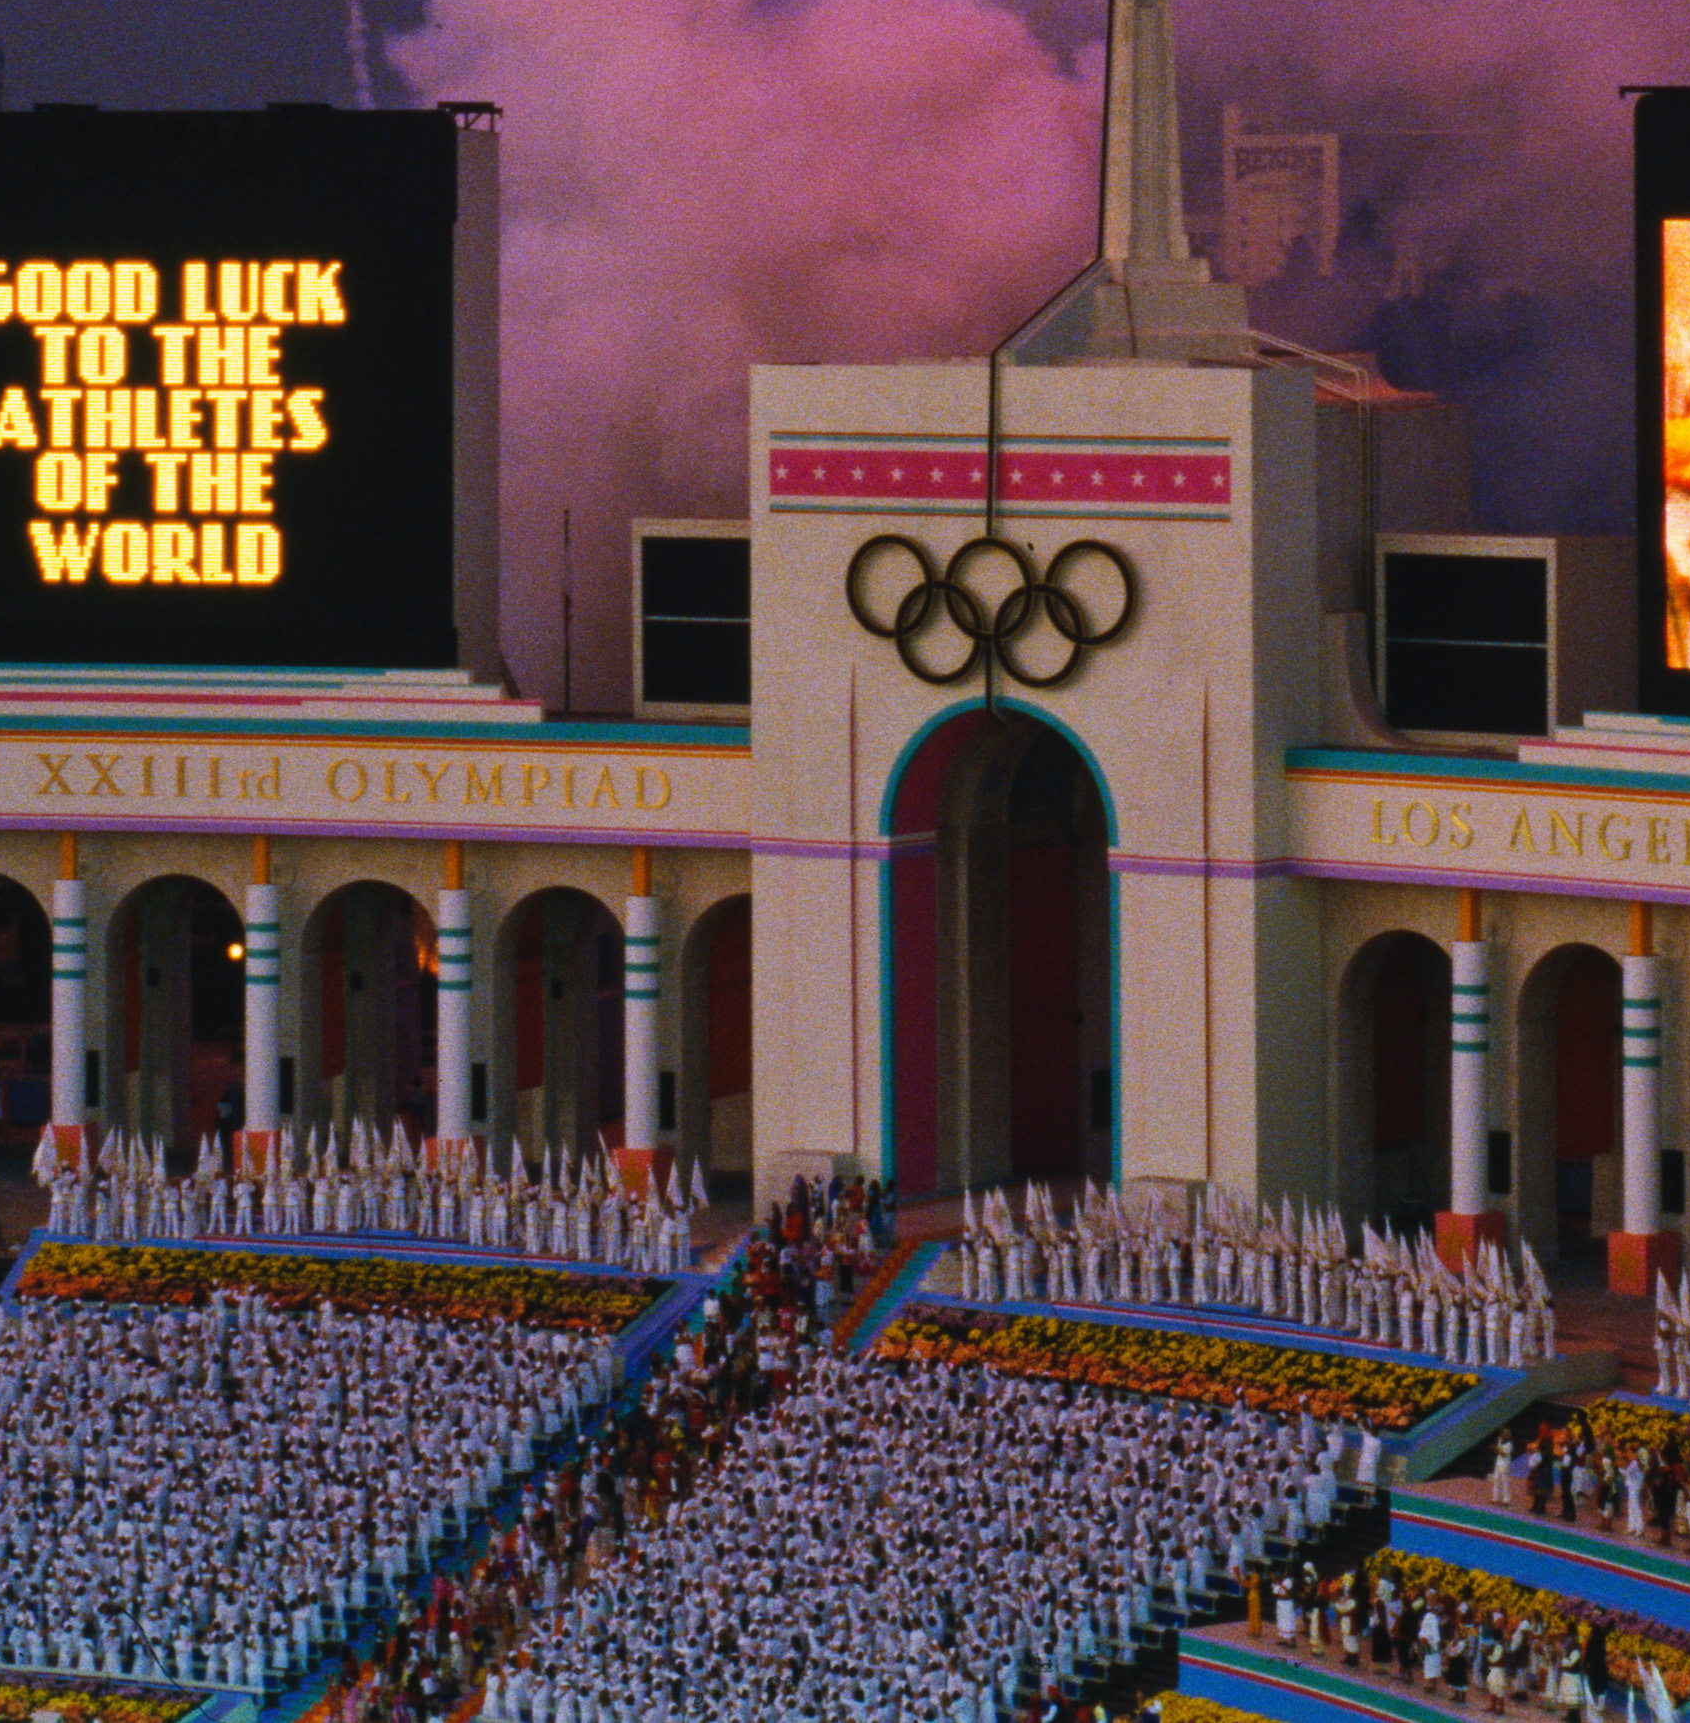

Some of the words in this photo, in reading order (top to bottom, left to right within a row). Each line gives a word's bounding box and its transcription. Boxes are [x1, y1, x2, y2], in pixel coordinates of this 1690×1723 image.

[182, 261, 347, 325] LUCK
[33, 326, 128, 386] TO
[152, 326, 282, 386] THE
[34, 451, 120, 513] OF
[144, 451, 276, 513] THE
[28, 520, 283, 585] WORLD
[34, 751, 284, 802] XXIIIrd
[324, 757, 674, 812] OLYMPIAD
[1368, 797, 1475, 850] LOS
